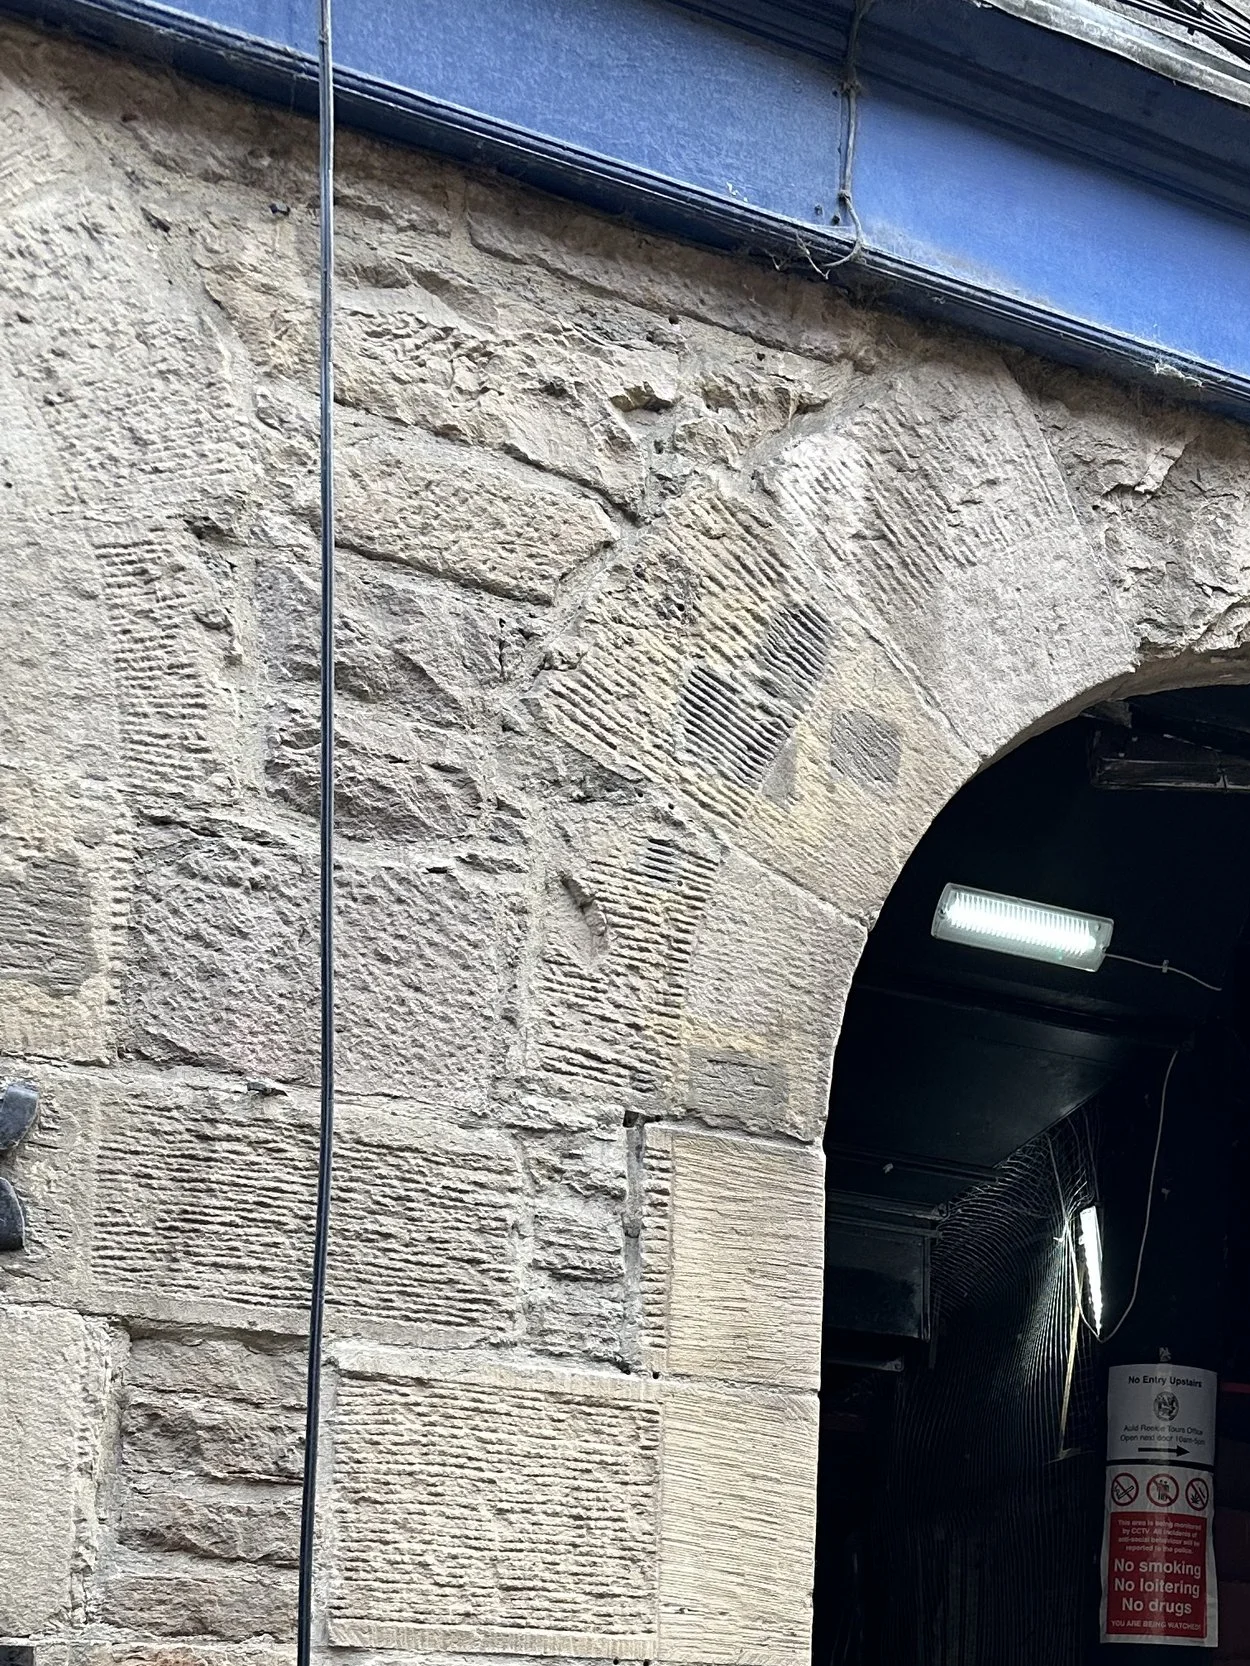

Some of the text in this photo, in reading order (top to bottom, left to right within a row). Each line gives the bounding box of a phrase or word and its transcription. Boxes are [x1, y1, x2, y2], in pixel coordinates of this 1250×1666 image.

[1128, 1375, 1202, 1388] No Entry Upstairs
[1167, 1425, 1185, 1434] Tours
[1120, 1434, 1138, 1442] Open
[1156, 1434, 1173, 1442] door
[1114, 1558, 1201, 1579] No smoking
[1114, 1577, 1200, 1599] No loitering
[1122, 1597, 1192, 1617] No drugs
[1111, 1619, 1125, 1627] YOU
[1126, 1619, 1141, 1627] ARE
[1142, 1620, 1167, 1628] BEING
